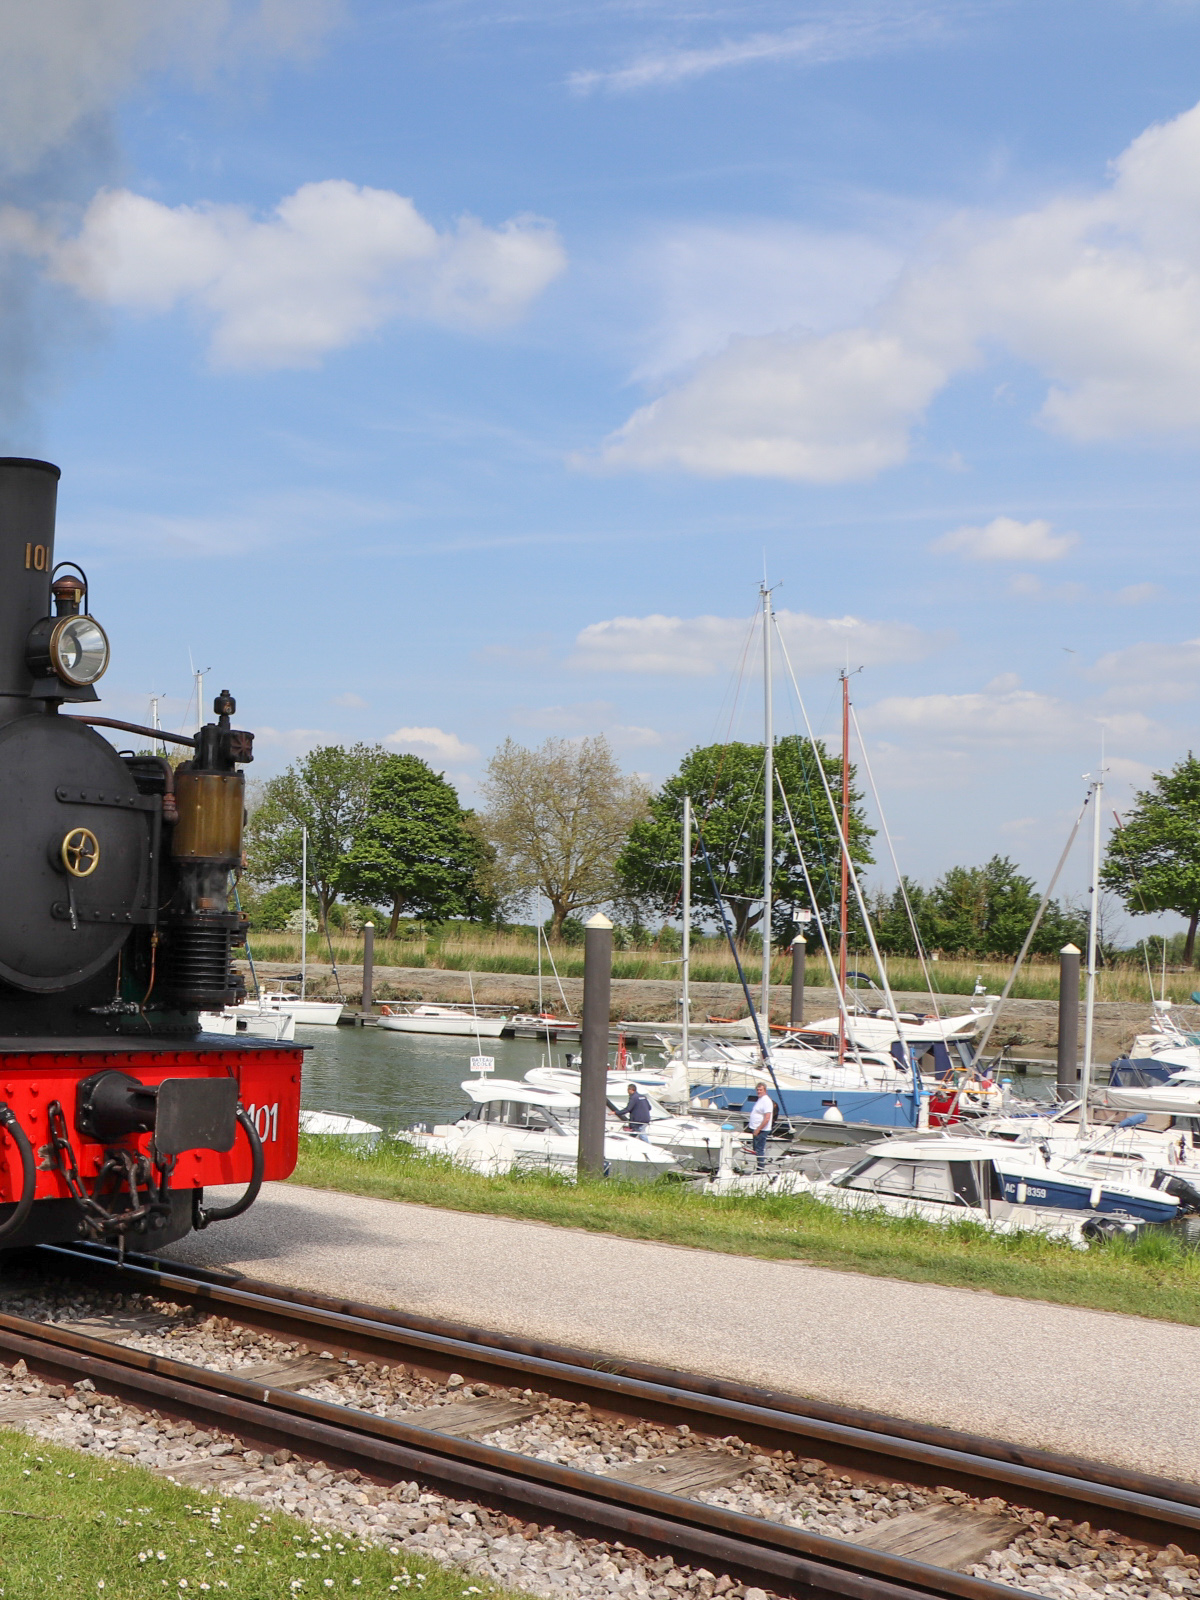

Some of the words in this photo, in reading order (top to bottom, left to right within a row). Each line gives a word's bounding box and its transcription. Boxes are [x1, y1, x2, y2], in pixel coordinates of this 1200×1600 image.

[25, 542, 50, 572] 101
[247, 1102, 279, 1143] 101
[1004, 1183, 1016, 1194] AC
